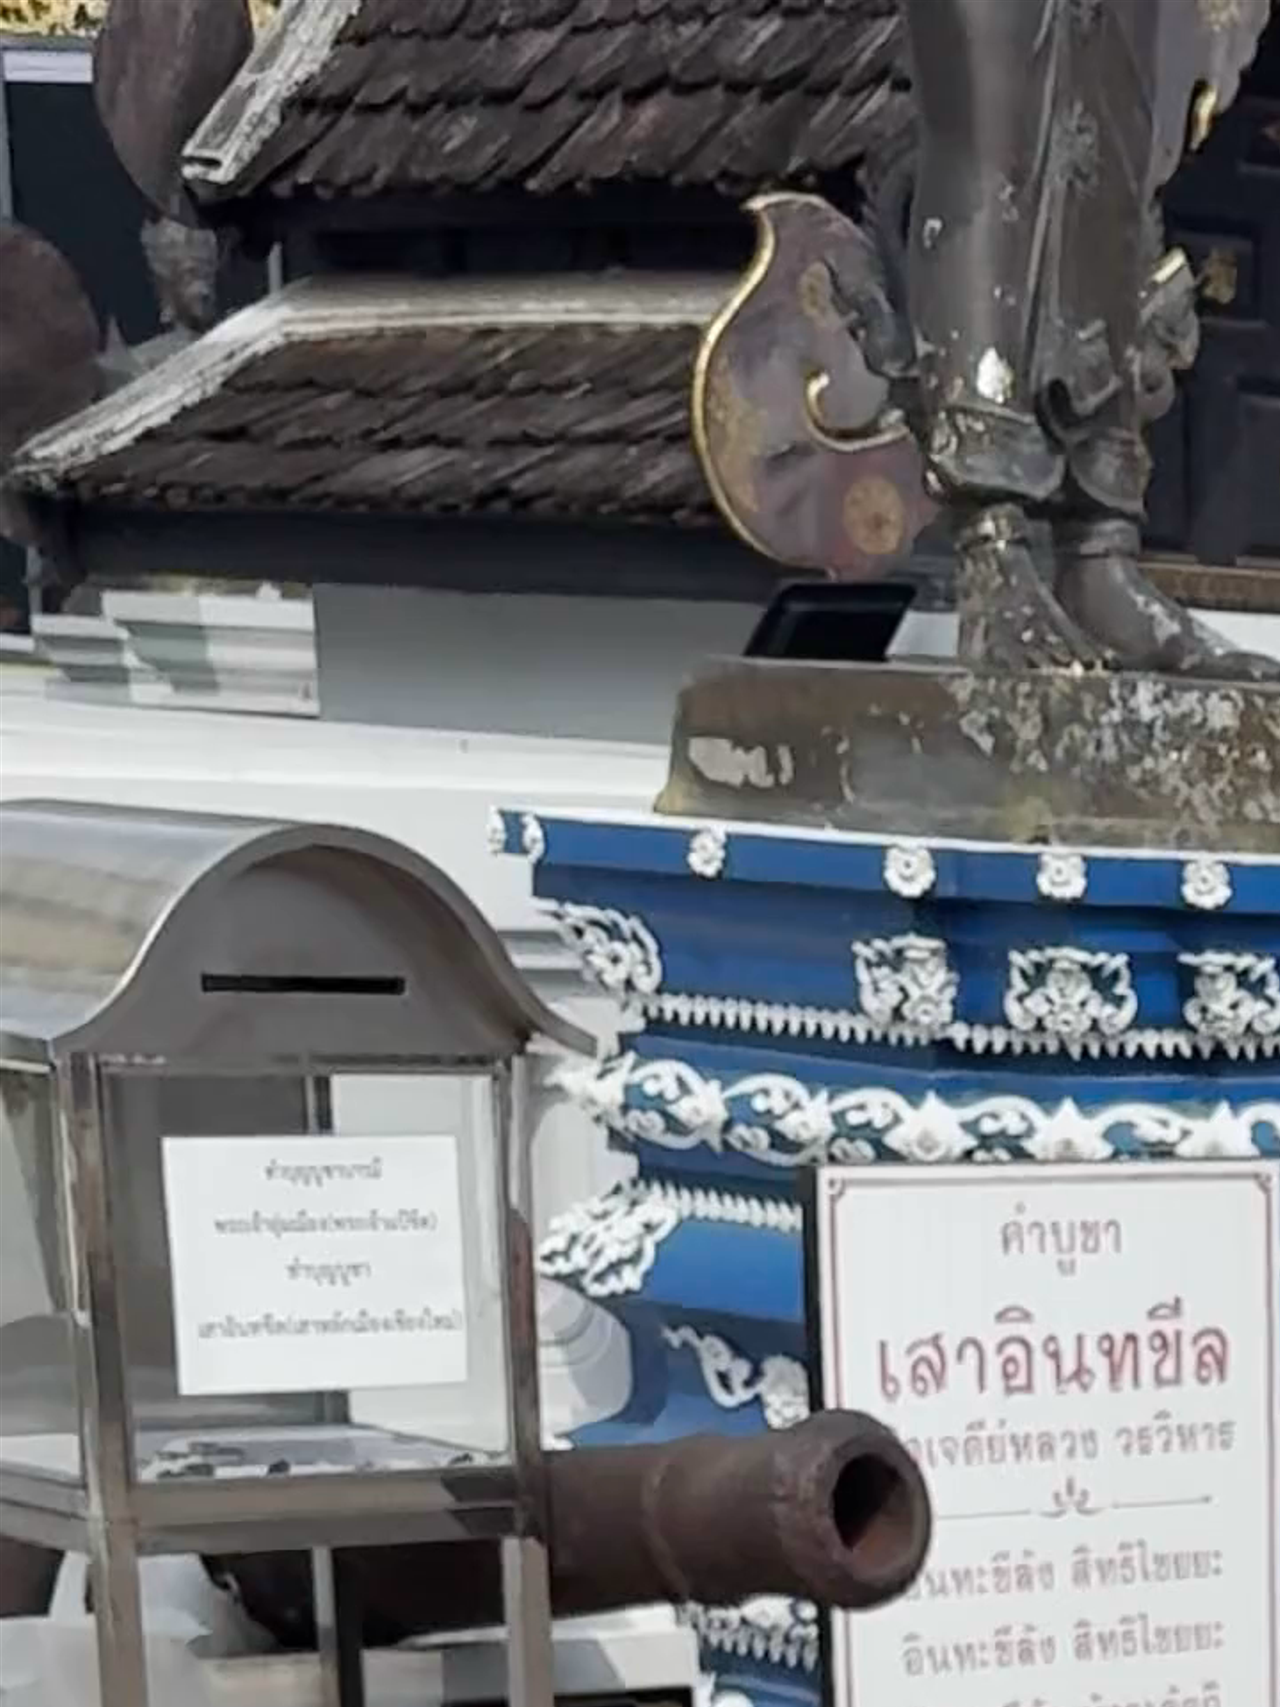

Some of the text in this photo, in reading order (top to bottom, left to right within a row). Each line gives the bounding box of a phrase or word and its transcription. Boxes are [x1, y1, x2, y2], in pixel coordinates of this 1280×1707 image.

[999, 1202, 1123, 1277] คำบูชา
[877, 1296, 1231, 1402] เสาอินทขีล
